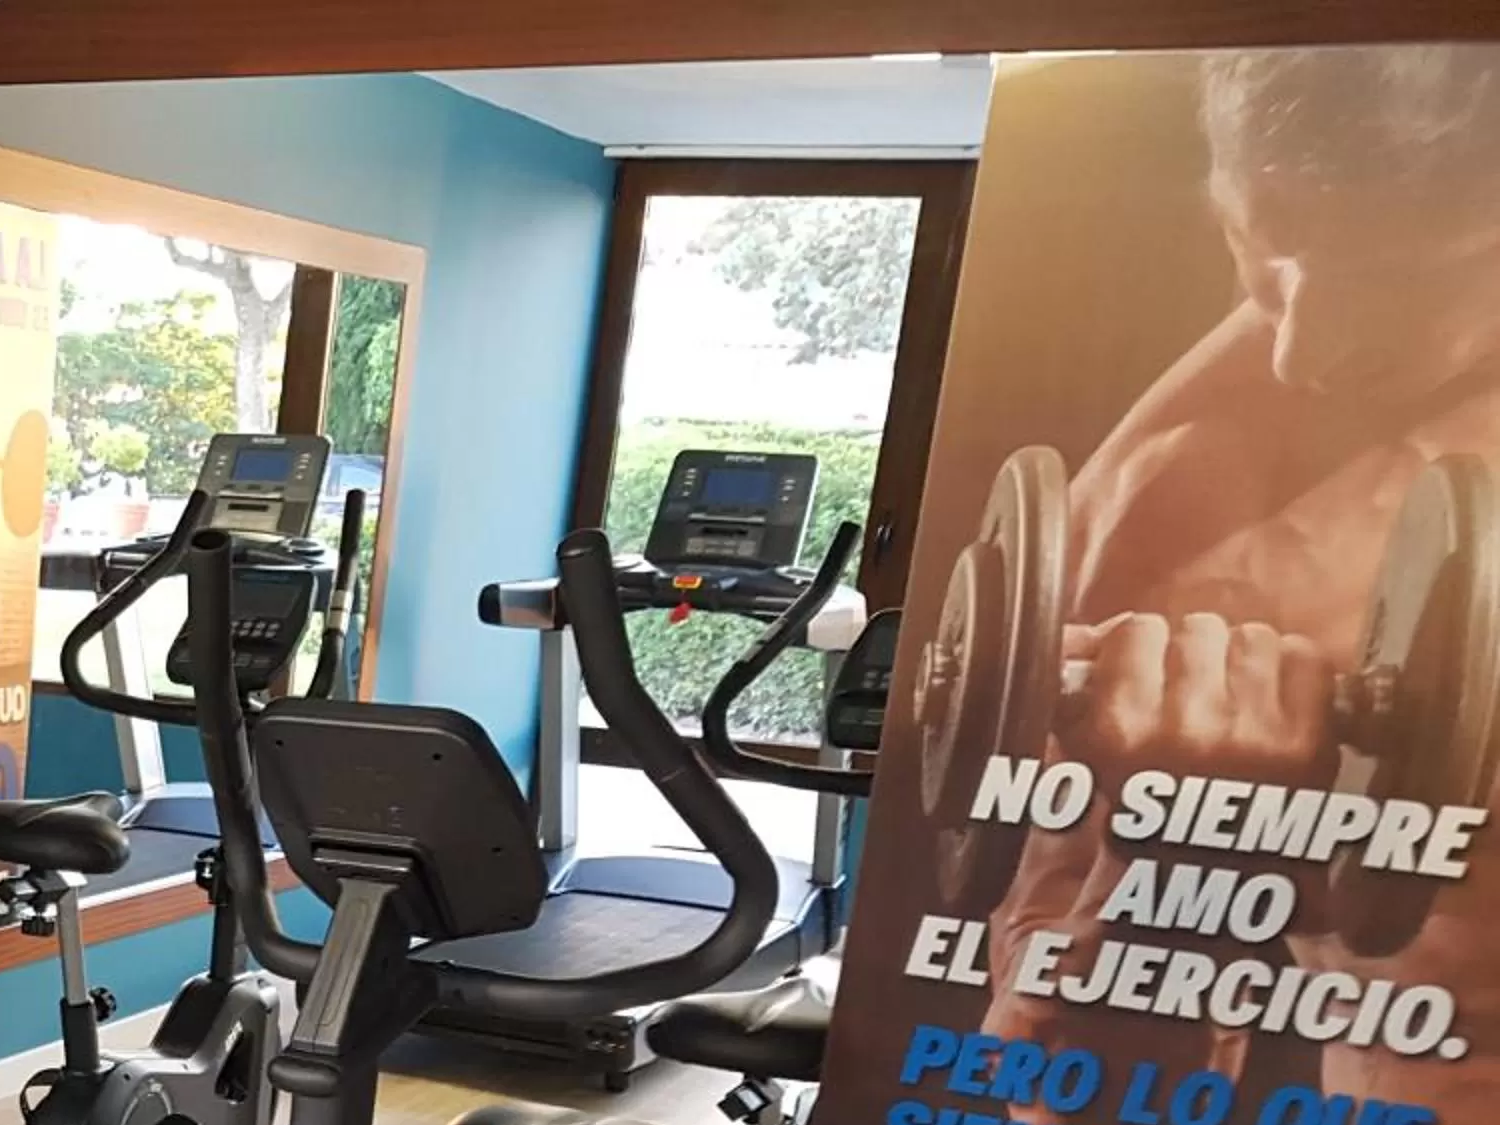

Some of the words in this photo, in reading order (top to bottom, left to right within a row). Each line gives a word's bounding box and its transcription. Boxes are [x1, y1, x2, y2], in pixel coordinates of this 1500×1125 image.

[969, 755, 1093, 832] NO
[1111, 770, 1488, 880] SIEMPRE
[1097, 857, 1298, 944] AMO
[905, 915, 990, 989] EL
[1014, 931, 1468, 1062] EJERCICIO.
[900, 1025, 1099, 1114] PERO
